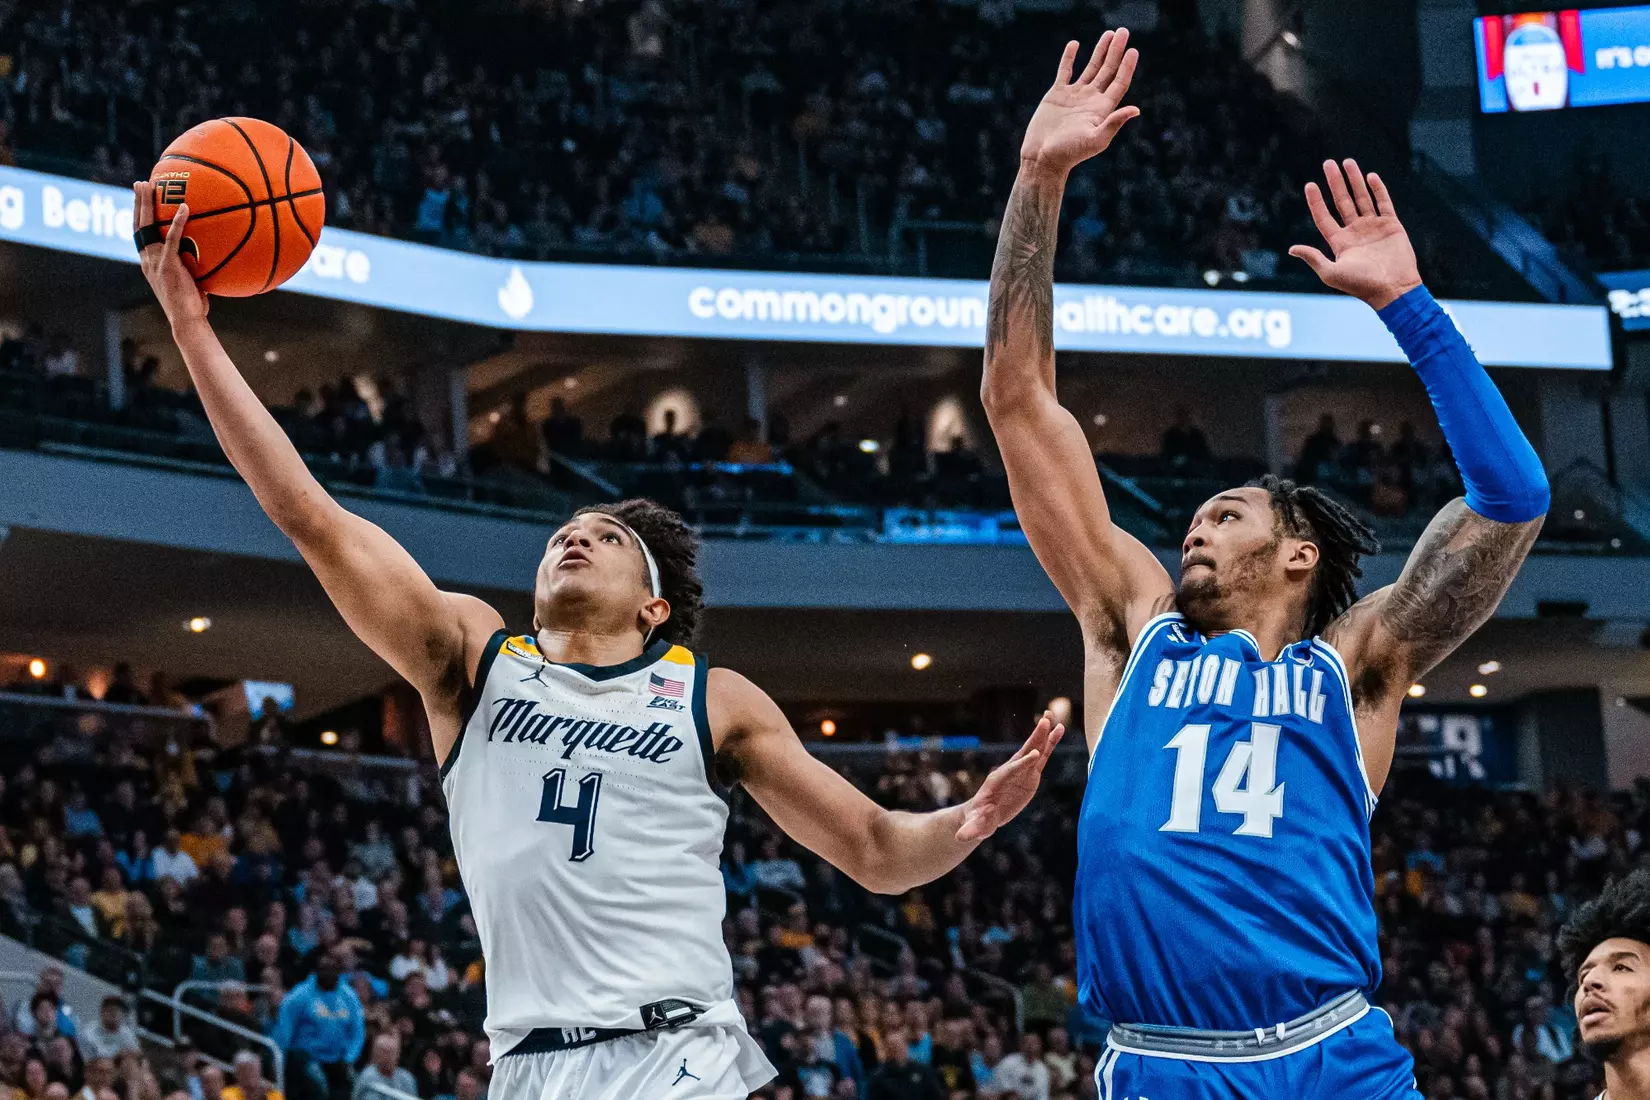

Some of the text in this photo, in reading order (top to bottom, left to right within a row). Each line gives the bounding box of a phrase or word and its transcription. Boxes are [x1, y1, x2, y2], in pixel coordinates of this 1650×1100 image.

[42, 185, 134, 240] Bette
[308, 244, 371, 283] are
[688, 287, 1291, 348] commongrounalthcare.org
[488, 698, 684, 764] Marquette
[1252, 663, 1326, 725] HALL
[535, 767, 602, 862] 4
[1158, 722, 1285, 838] 14
